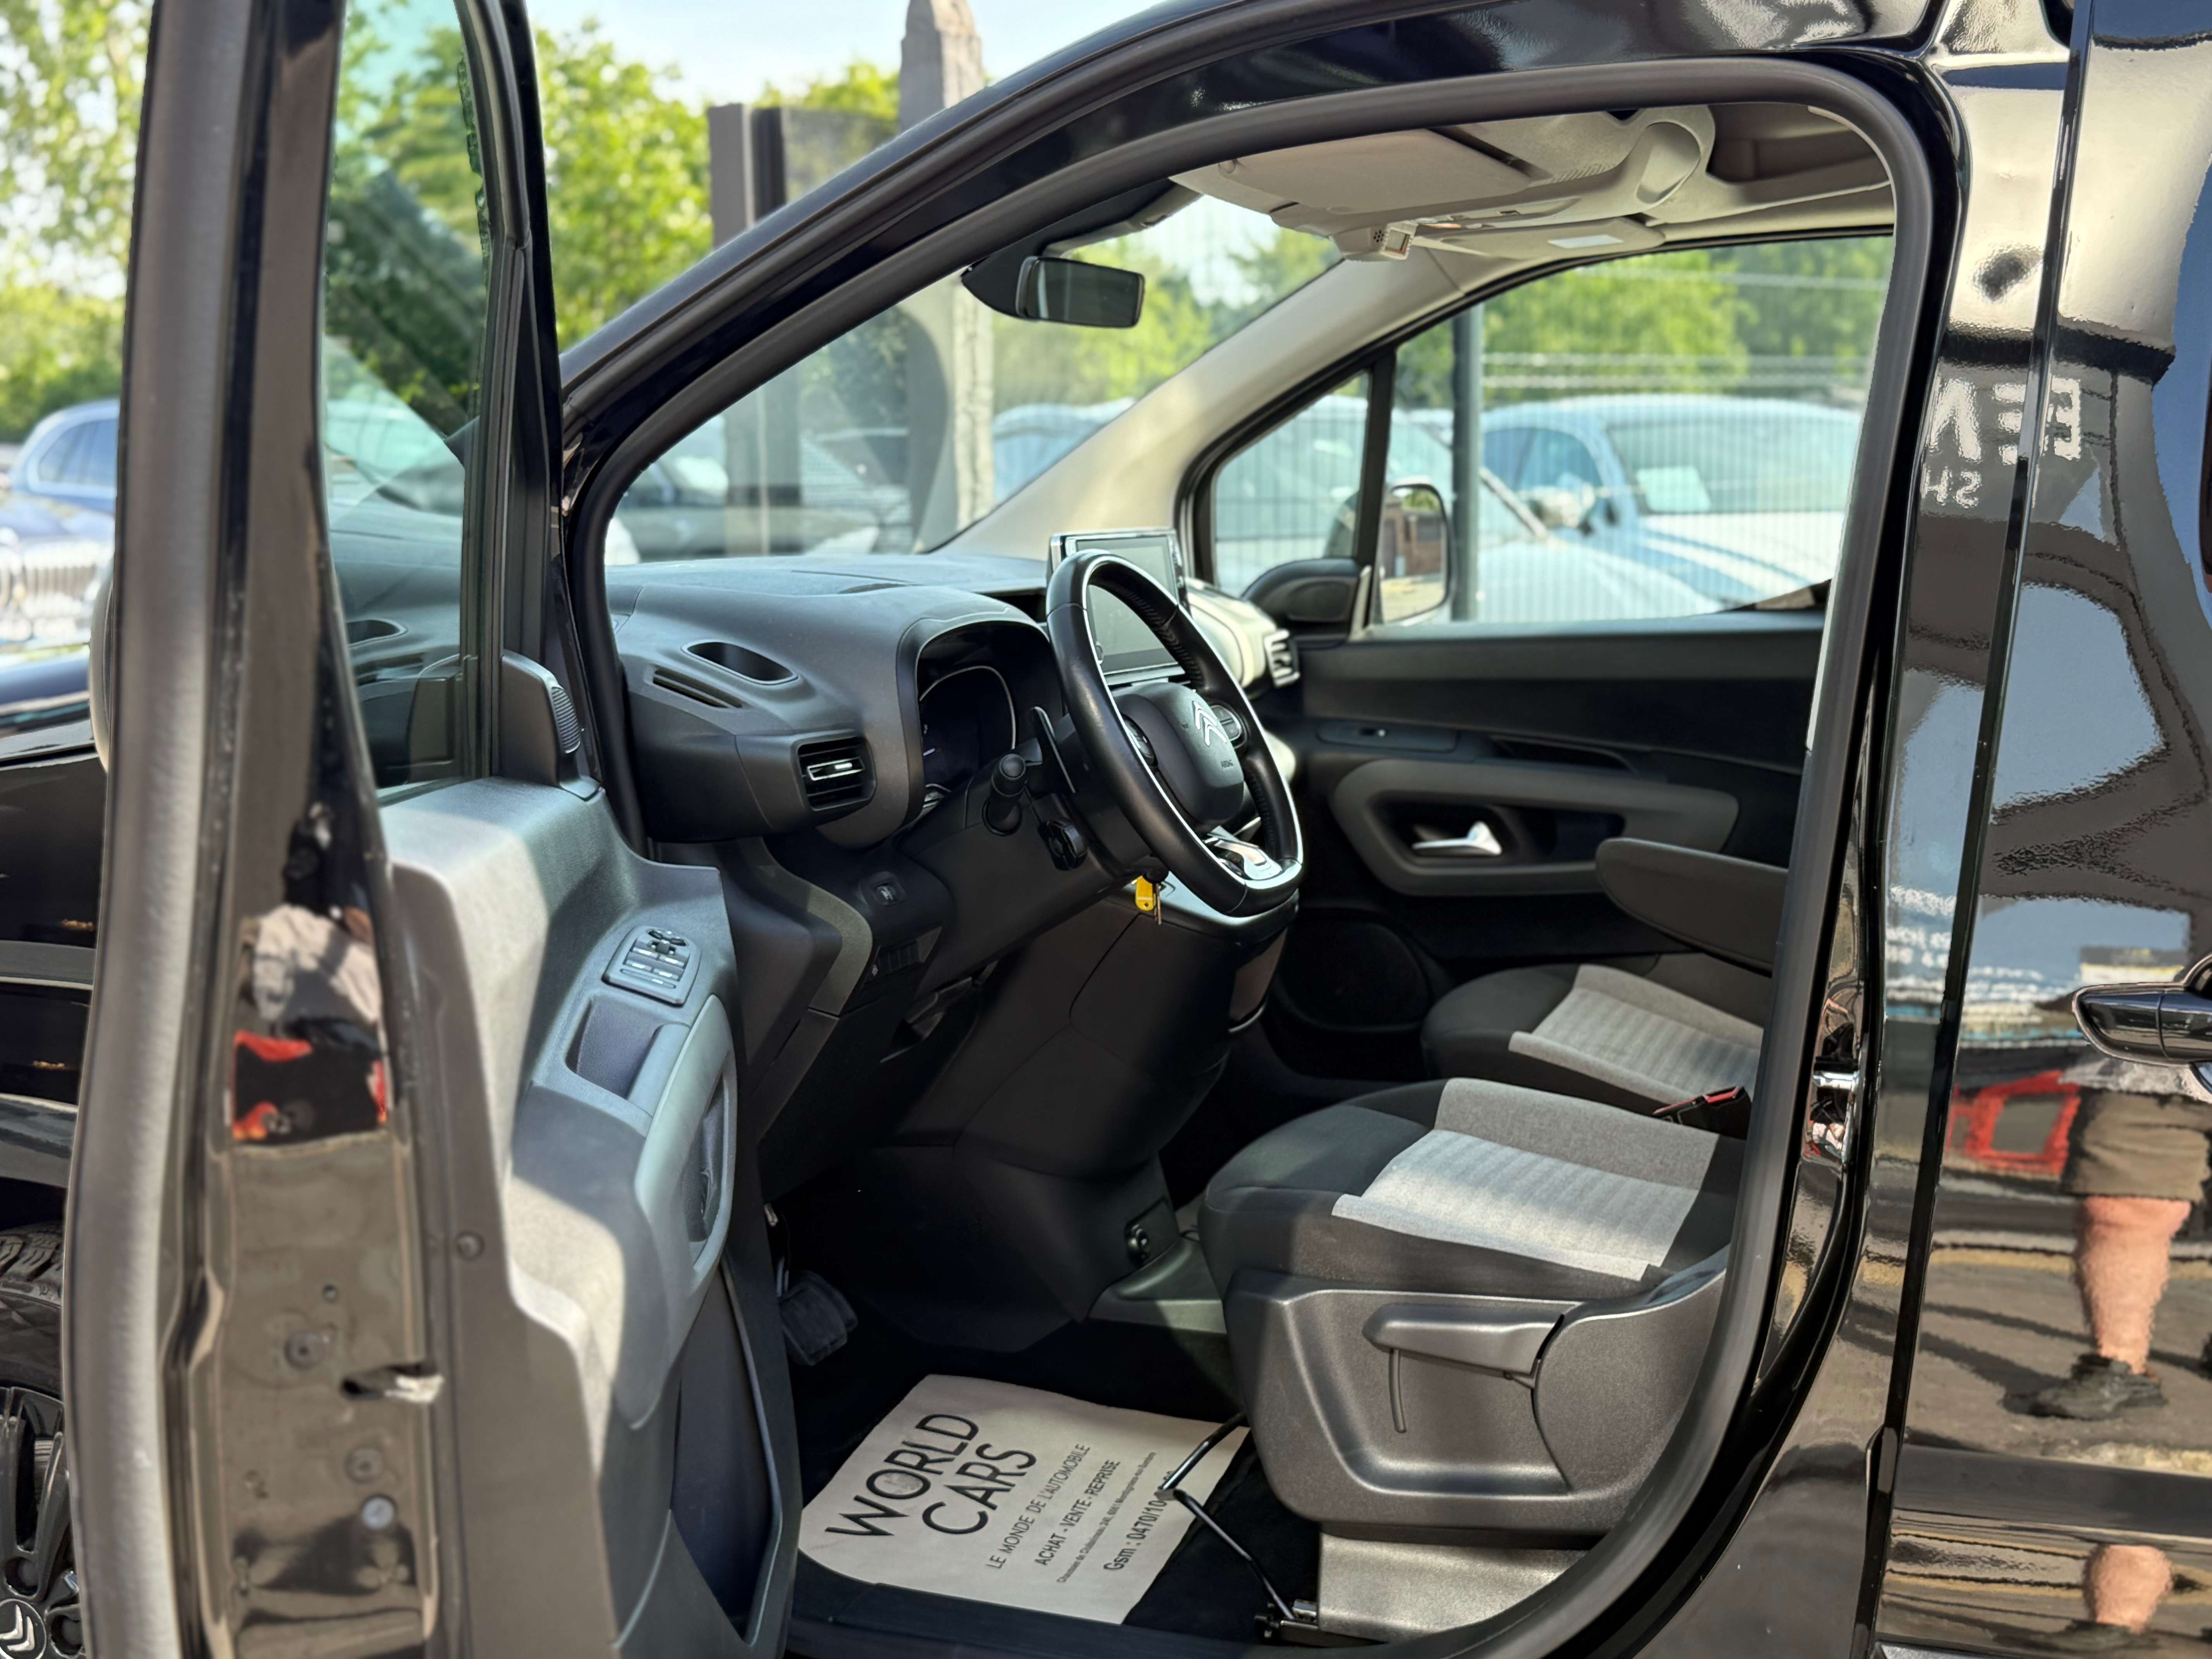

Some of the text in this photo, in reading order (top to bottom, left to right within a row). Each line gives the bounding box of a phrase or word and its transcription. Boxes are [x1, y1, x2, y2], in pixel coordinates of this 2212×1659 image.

[825, 1413, 979, 1537] WORLD
[922, 1443, 1037, 1535] CARS
[985, 1444, 1090, 1568] LE MONDE DE L'AUTOMOBILE
[1035, 1532, 1067, 1565] ACHAT
[1059, 1498, 1092, 1527] VENTE
[1084, 1460, 1121, 1496] REPRISE
[1104, 1548, 1137, 1570] Gsm
